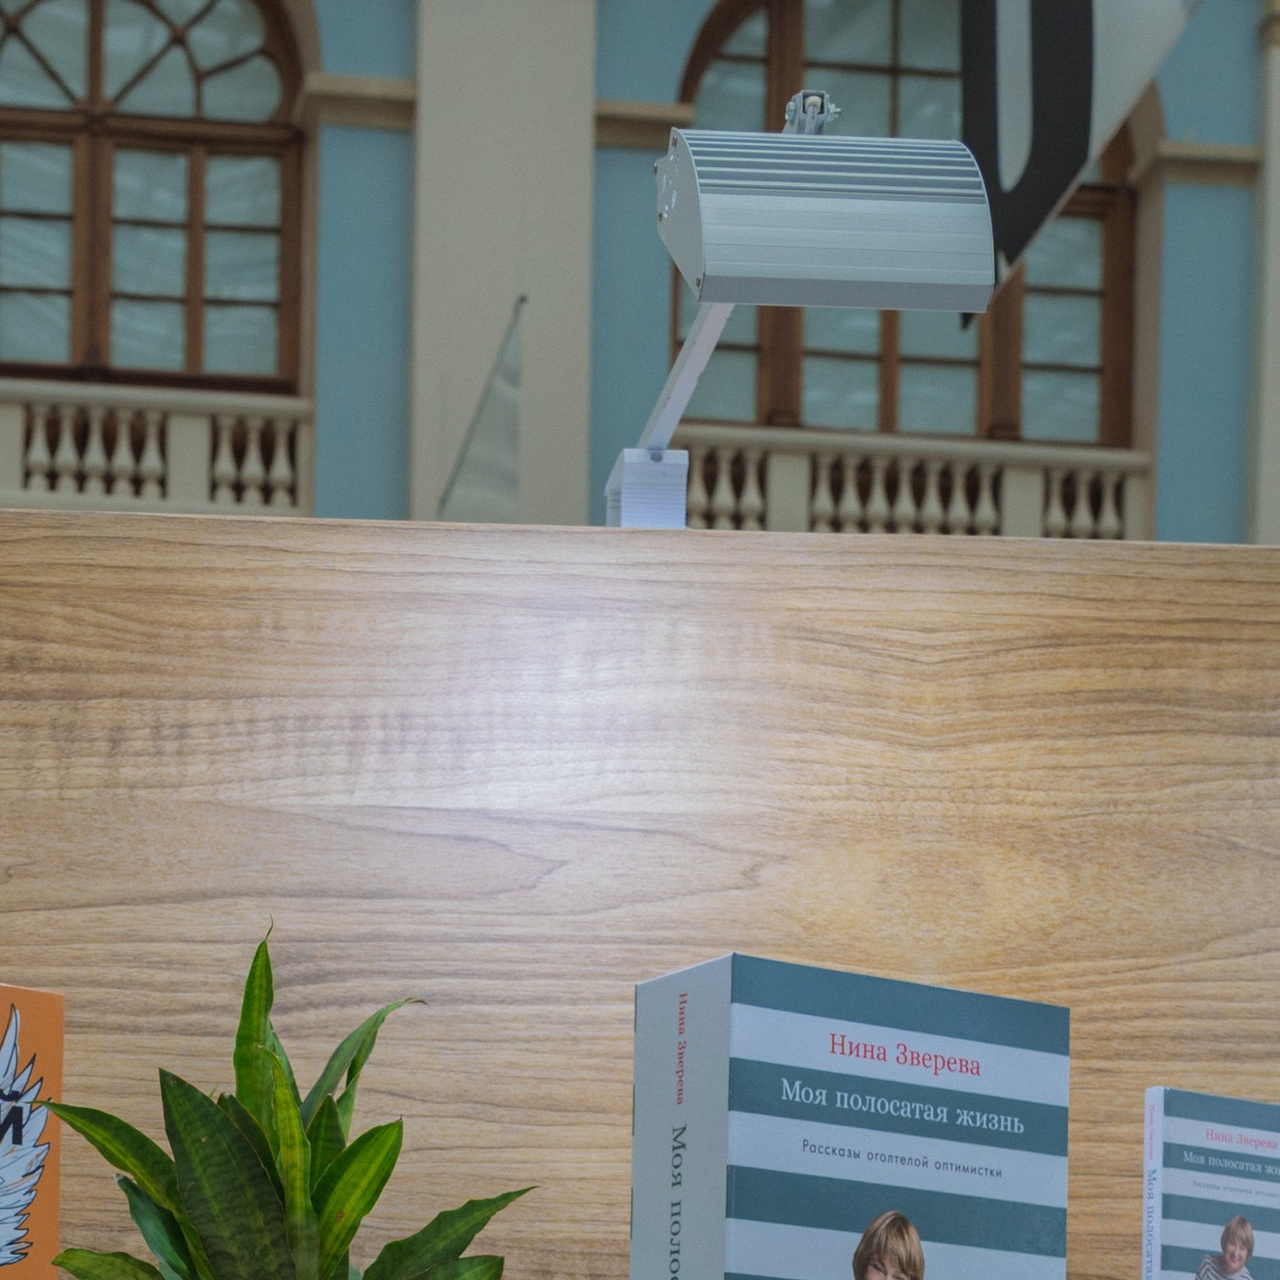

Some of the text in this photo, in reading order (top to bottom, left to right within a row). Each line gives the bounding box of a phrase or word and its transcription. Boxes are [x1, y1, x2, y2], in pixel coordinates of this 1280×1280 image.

[677, 991, 689, 1036] Нина
[677, 1040, 688, 1106] Зверева
[829, 1032, 981, 1077] Нина Зверева
[781, 1077, 1025, 1134] Моя полосатая жизнь
[670, 1123, 688, 1189] Моя
[802, 1138, 1003, 1179] Рассказы оголтелой оптимистки
[1183, 1150, 1205, 1165] Моя
[1208, 1156, 1262, 1173] полосатая
[1206, 1129, 1278, 1150] Нина Зверева
[1146, 1169, 1157, 1200] Моя
